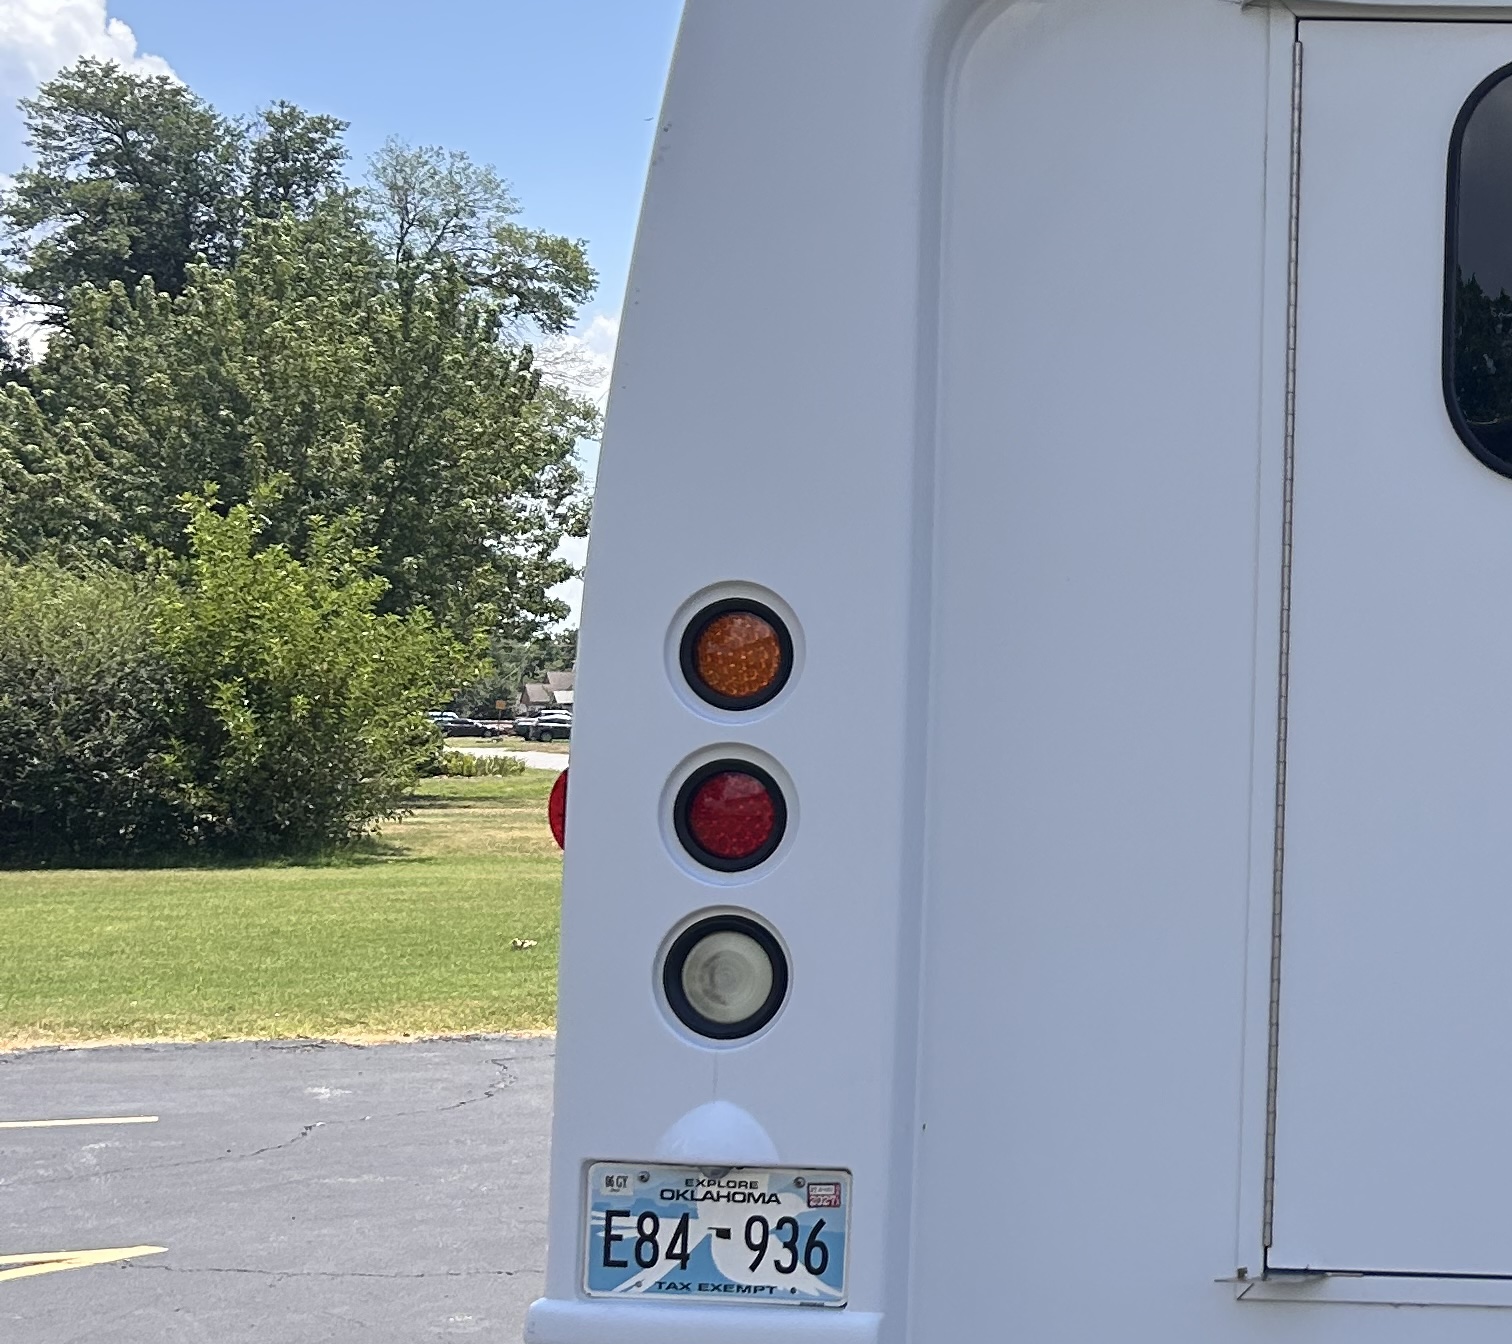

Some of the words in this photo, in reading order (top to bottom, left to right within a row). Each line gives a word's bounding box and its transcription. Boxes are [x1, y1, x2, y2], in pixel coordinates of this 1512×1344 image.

[685, 1178, 759, 1190] EXPLORE
[659, 1188, 782, 1205] OKLAHOMA
[603, 1210, 691, 1270] E84
[744, 1215, 830, 1276] 936
[655, 1281, 692, 1292] TAX
[697, 1282, 778, 1295] EXEMPT
